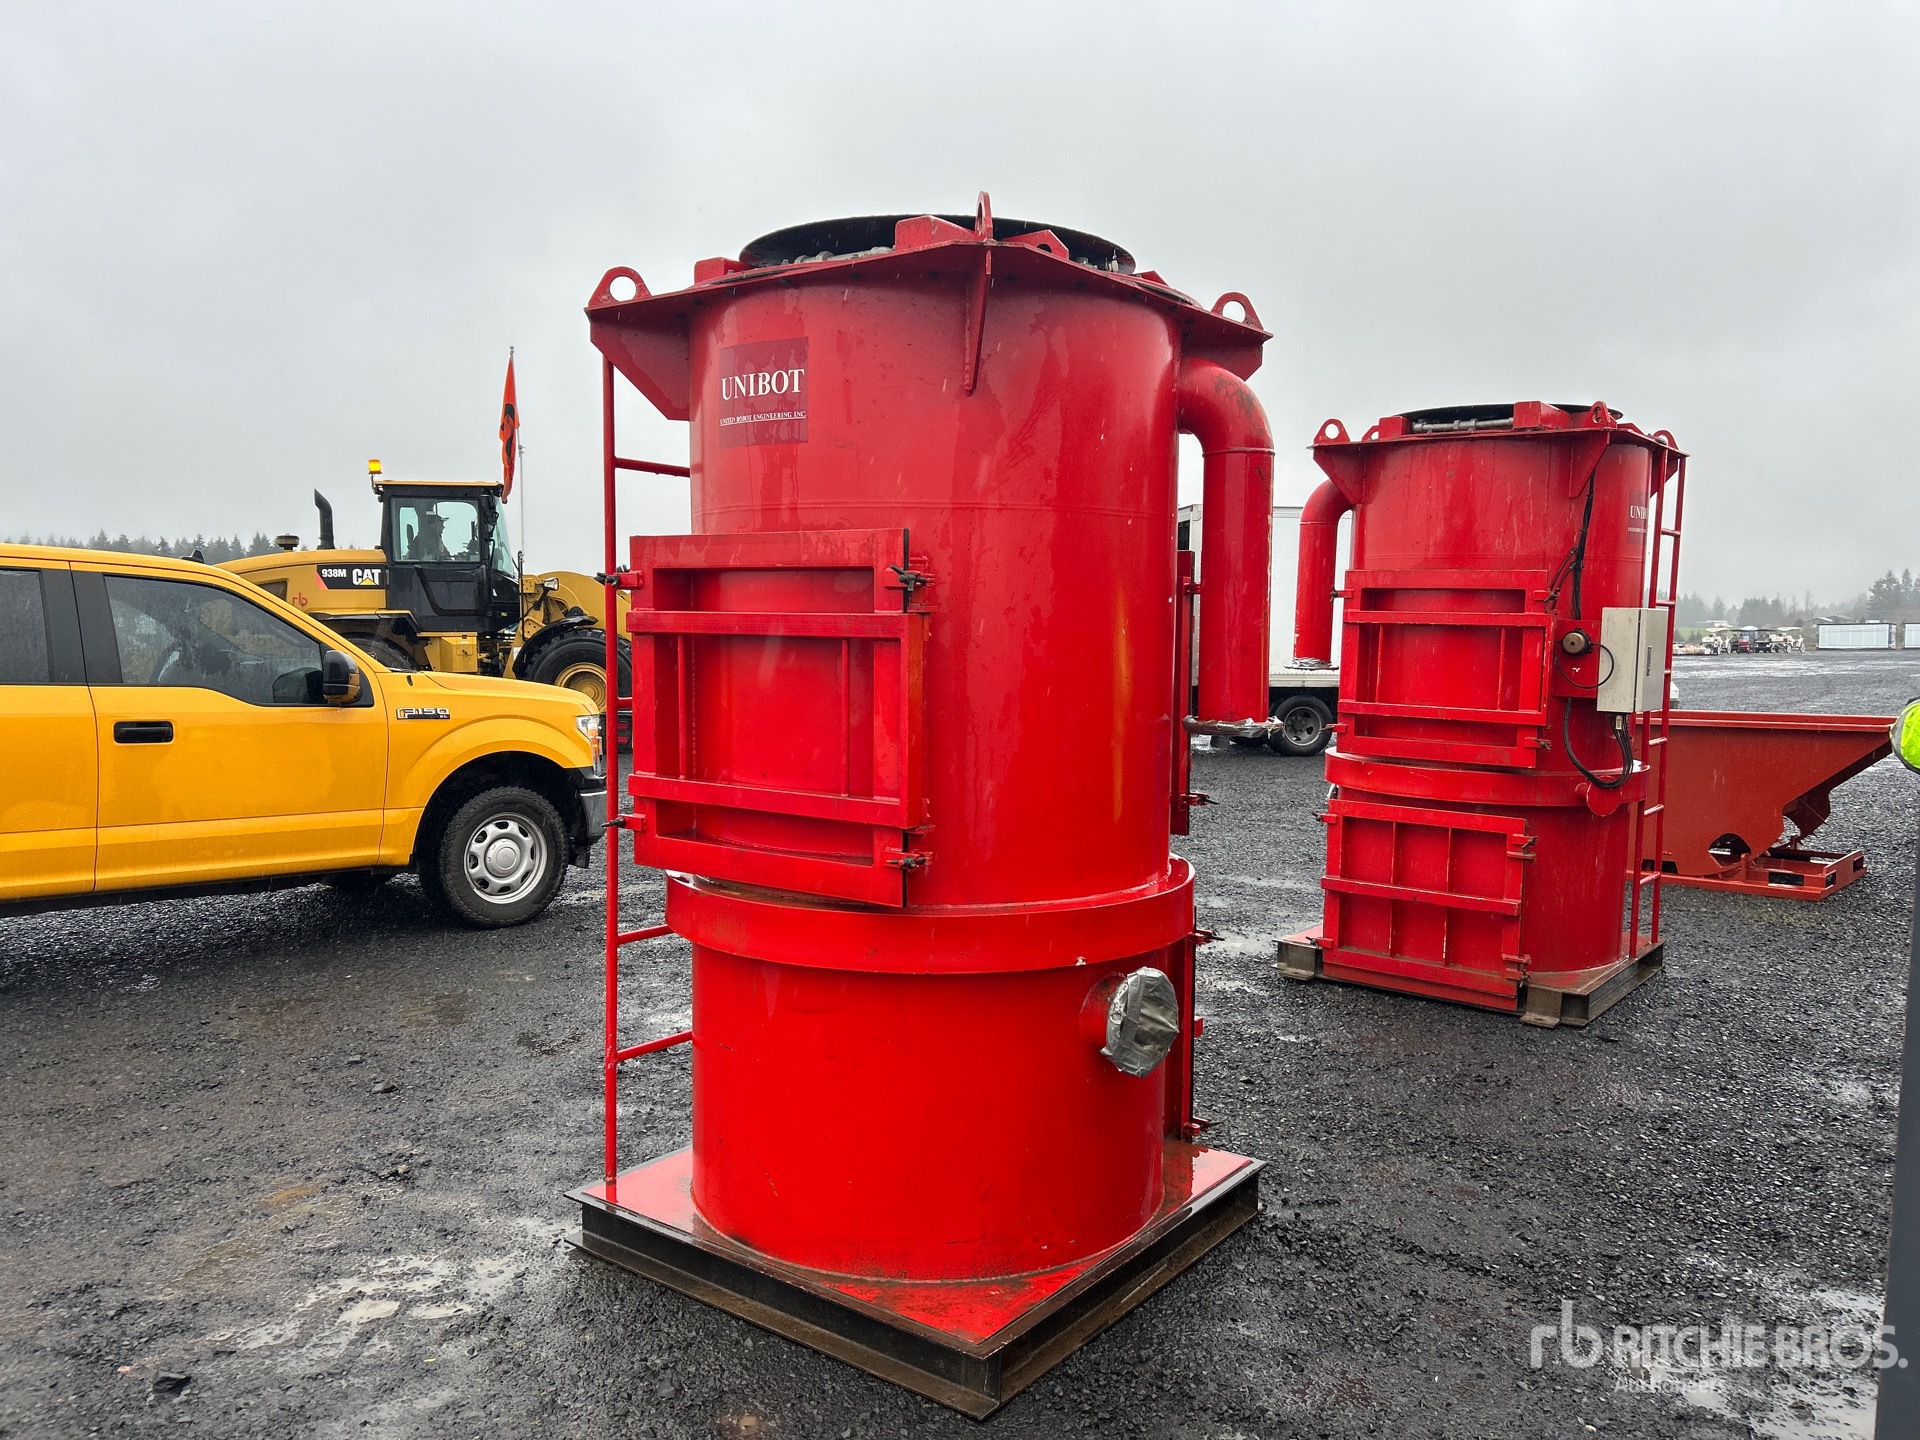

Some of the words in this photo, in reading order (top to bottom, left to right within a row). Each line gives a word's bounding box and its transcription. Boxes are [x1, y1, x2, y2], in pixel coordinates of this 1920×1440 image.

[721, 368, 805, 401] UNIBOT
[736, 414, 752, 423] ROBOT
[753, 411, 792, 420] ENGINEERING
[794, 410, 807, 418] INC.
[321, 568, 347, 578] 938M
[352, 568, 381, 586] CAT
